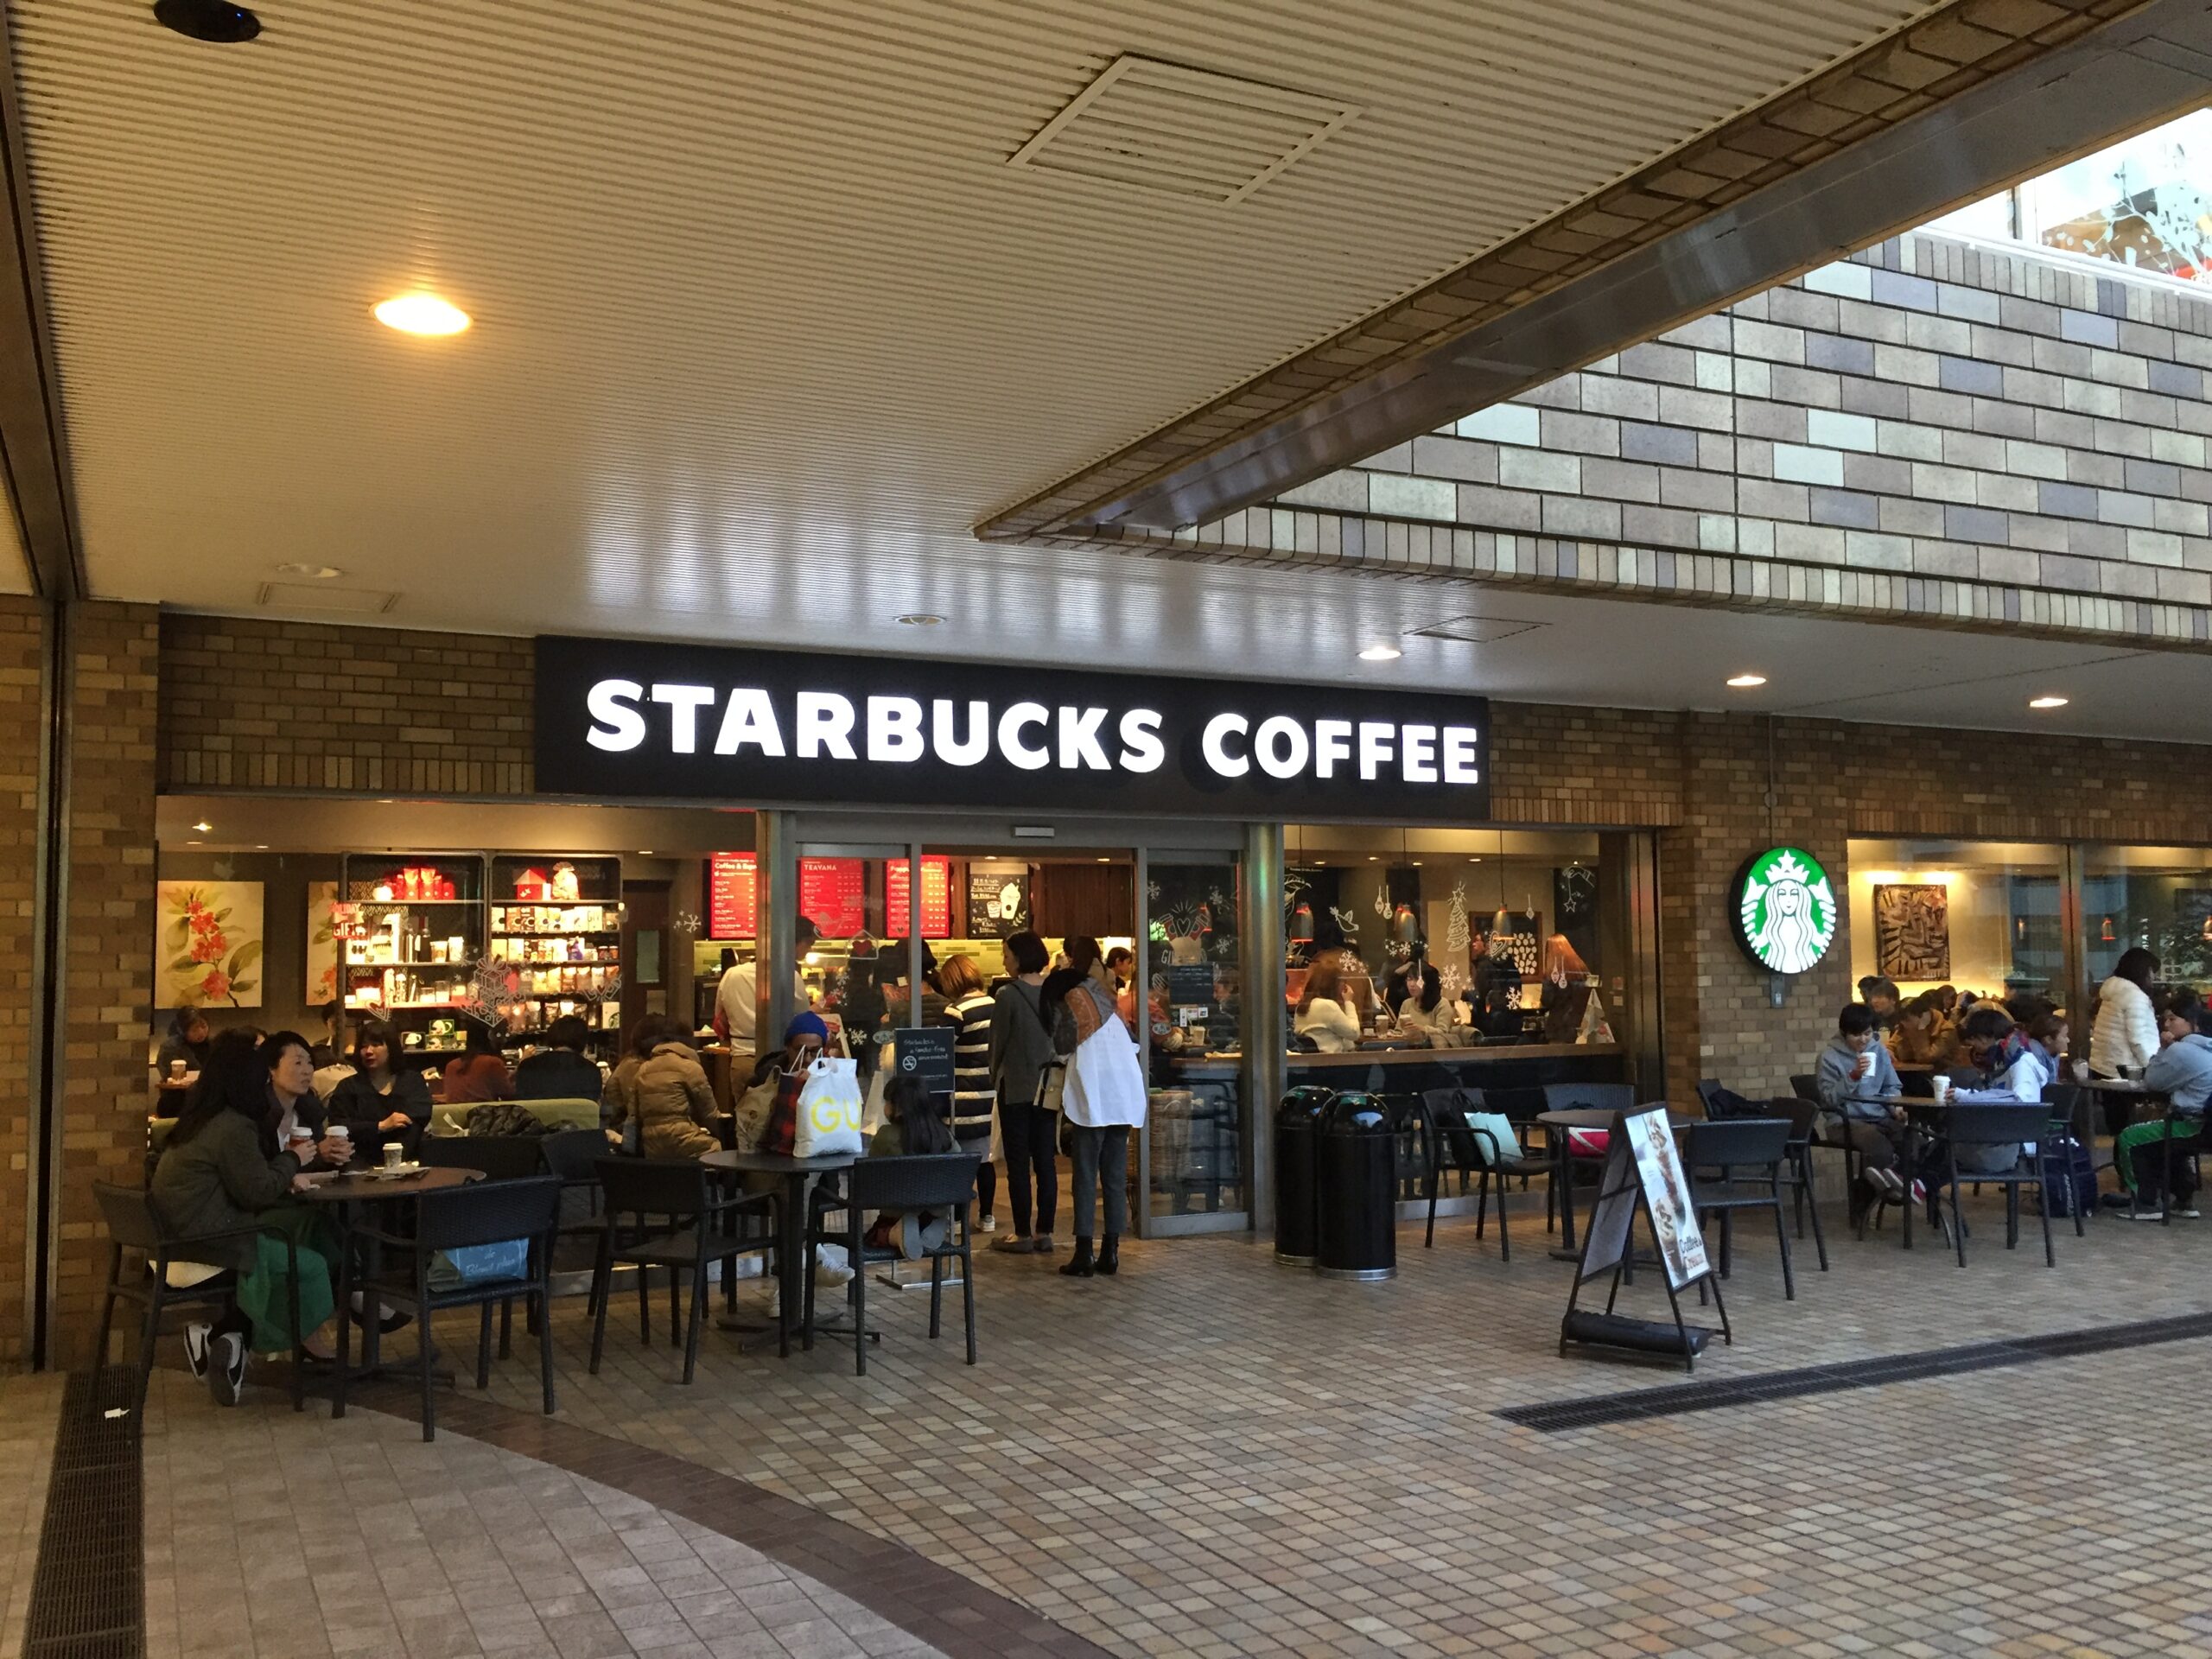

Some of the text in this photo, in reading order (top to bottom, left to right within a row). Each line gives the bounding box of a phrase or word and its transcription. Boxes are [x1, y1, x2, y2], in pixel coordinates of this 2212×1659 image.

[586, 679, 1478, 785] STARBUCKS COFFEE
[810, 1095, 862, 1135] GU
